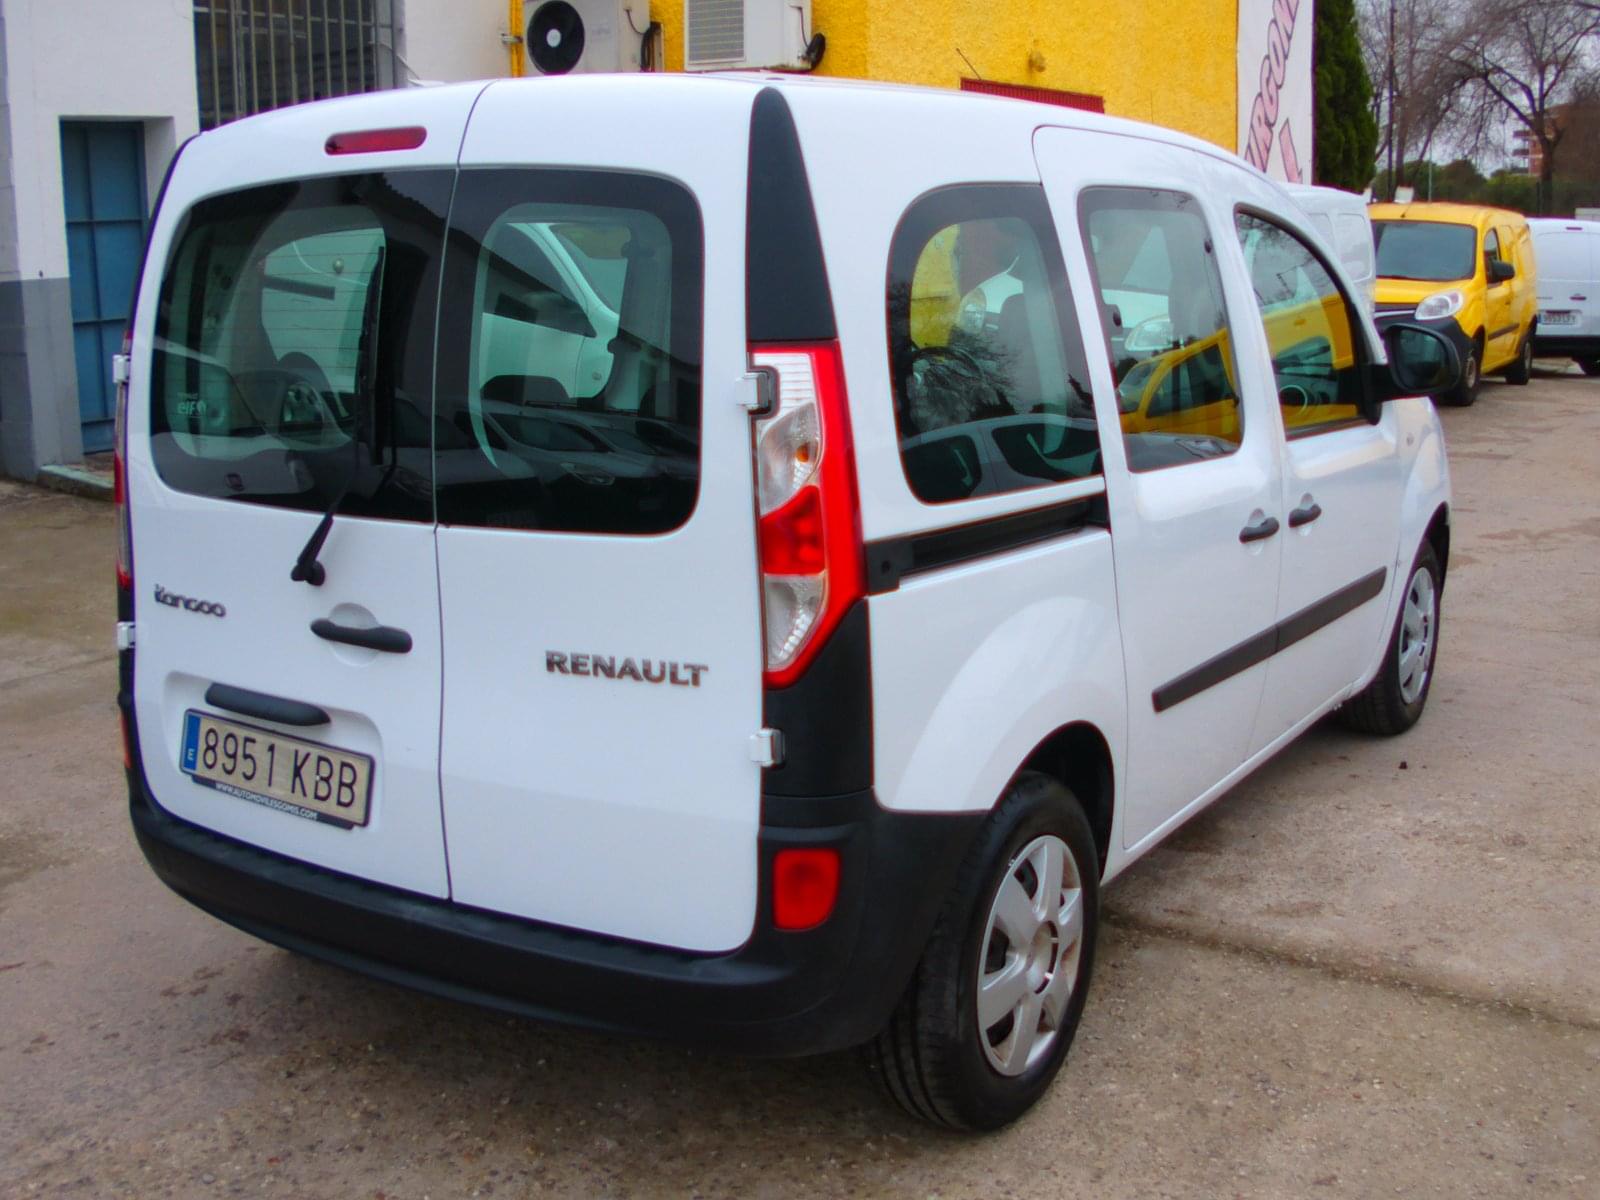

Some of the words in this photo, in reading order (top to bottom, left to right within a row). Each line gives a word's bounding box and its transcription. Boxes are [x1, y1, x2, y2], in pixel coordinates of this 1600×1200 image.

[545, 650, 709, 688] RENAULT
[187, 749, 195, 761] E
[202, 727, 276, 787] 8951
[291, 748, 358, 808] KBB
